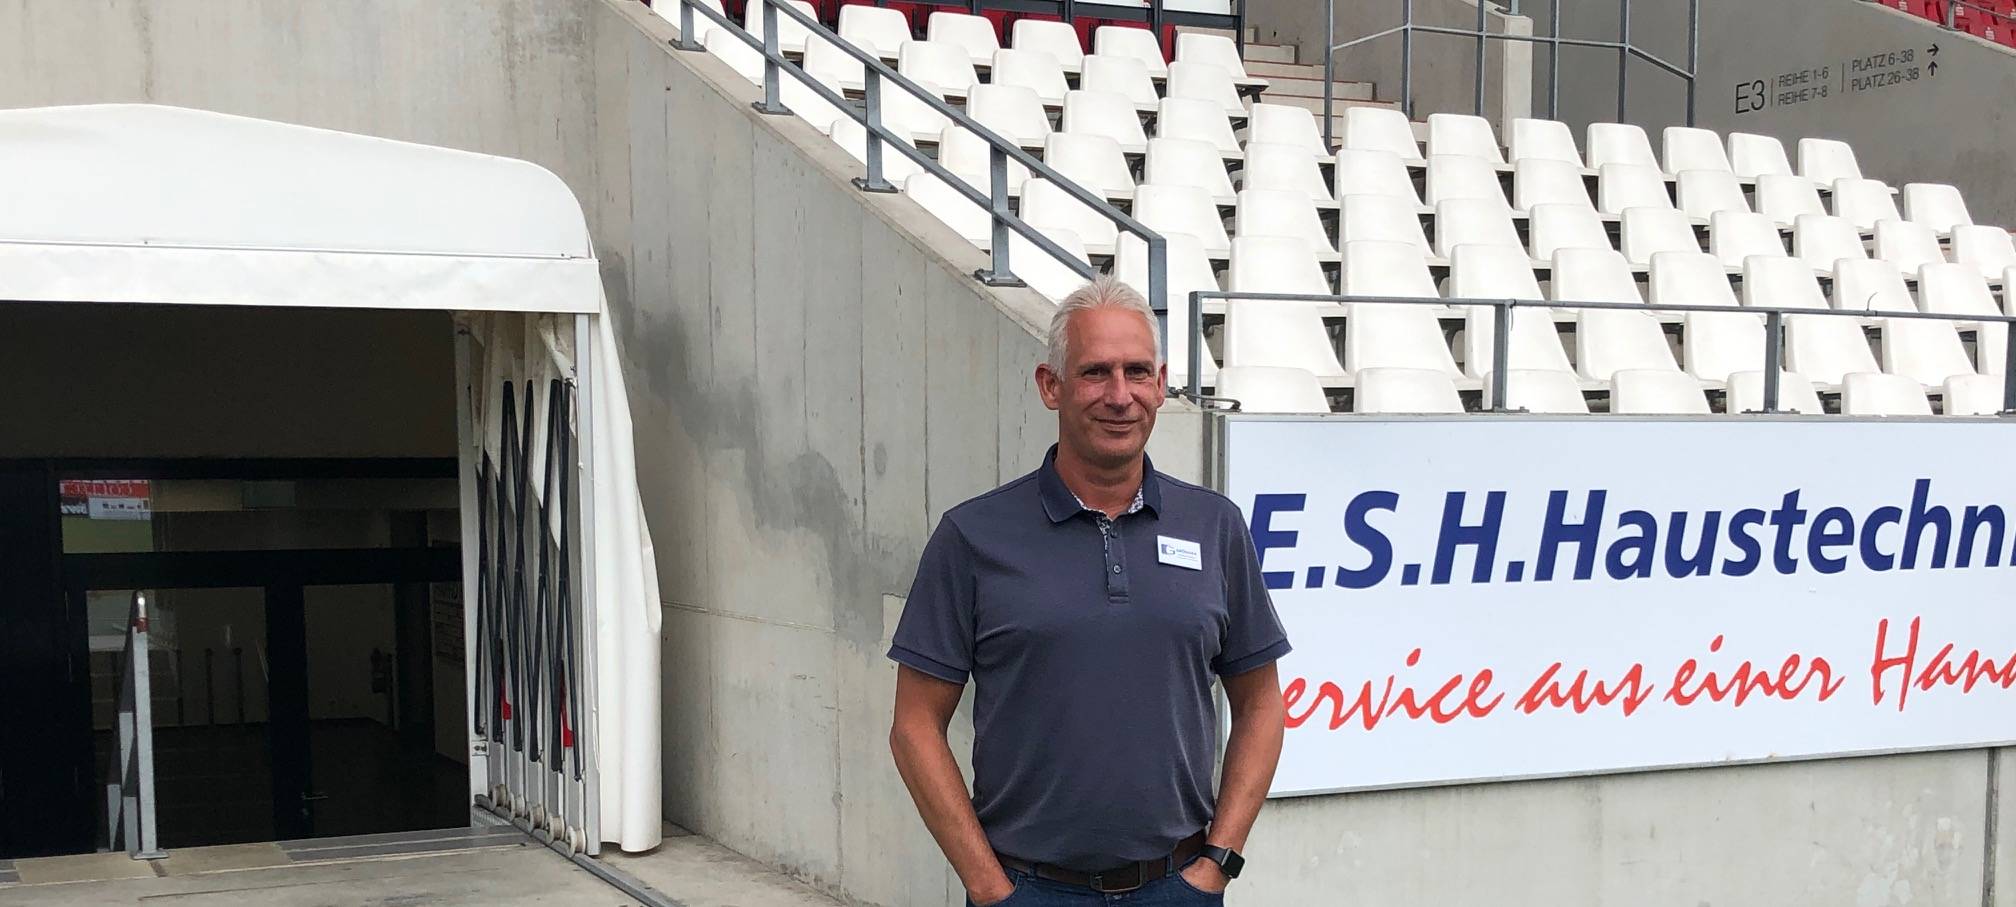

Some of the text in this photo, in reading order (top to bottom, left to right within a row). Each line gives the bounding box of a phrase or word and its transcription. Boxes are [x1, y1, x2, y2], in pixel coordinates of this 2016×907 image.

[1851, 49, 1915, 73] PLATZ 6-38
[1778, 66, 1829, 88] REIHE 1-6
[1851, 66, 1920, 92] PLATZ 26-38
[1735, 79, 1766, 114] E3
[1777, 85, 1828, 107] REIHE 7-8
[1250, 478, 2016, 589] E.S.H.Haustechn
[1281, 648, 1505, 731] ervice
[1515, 662, 1654, 717] aus
[1664, 634, 1844, 706] einer
